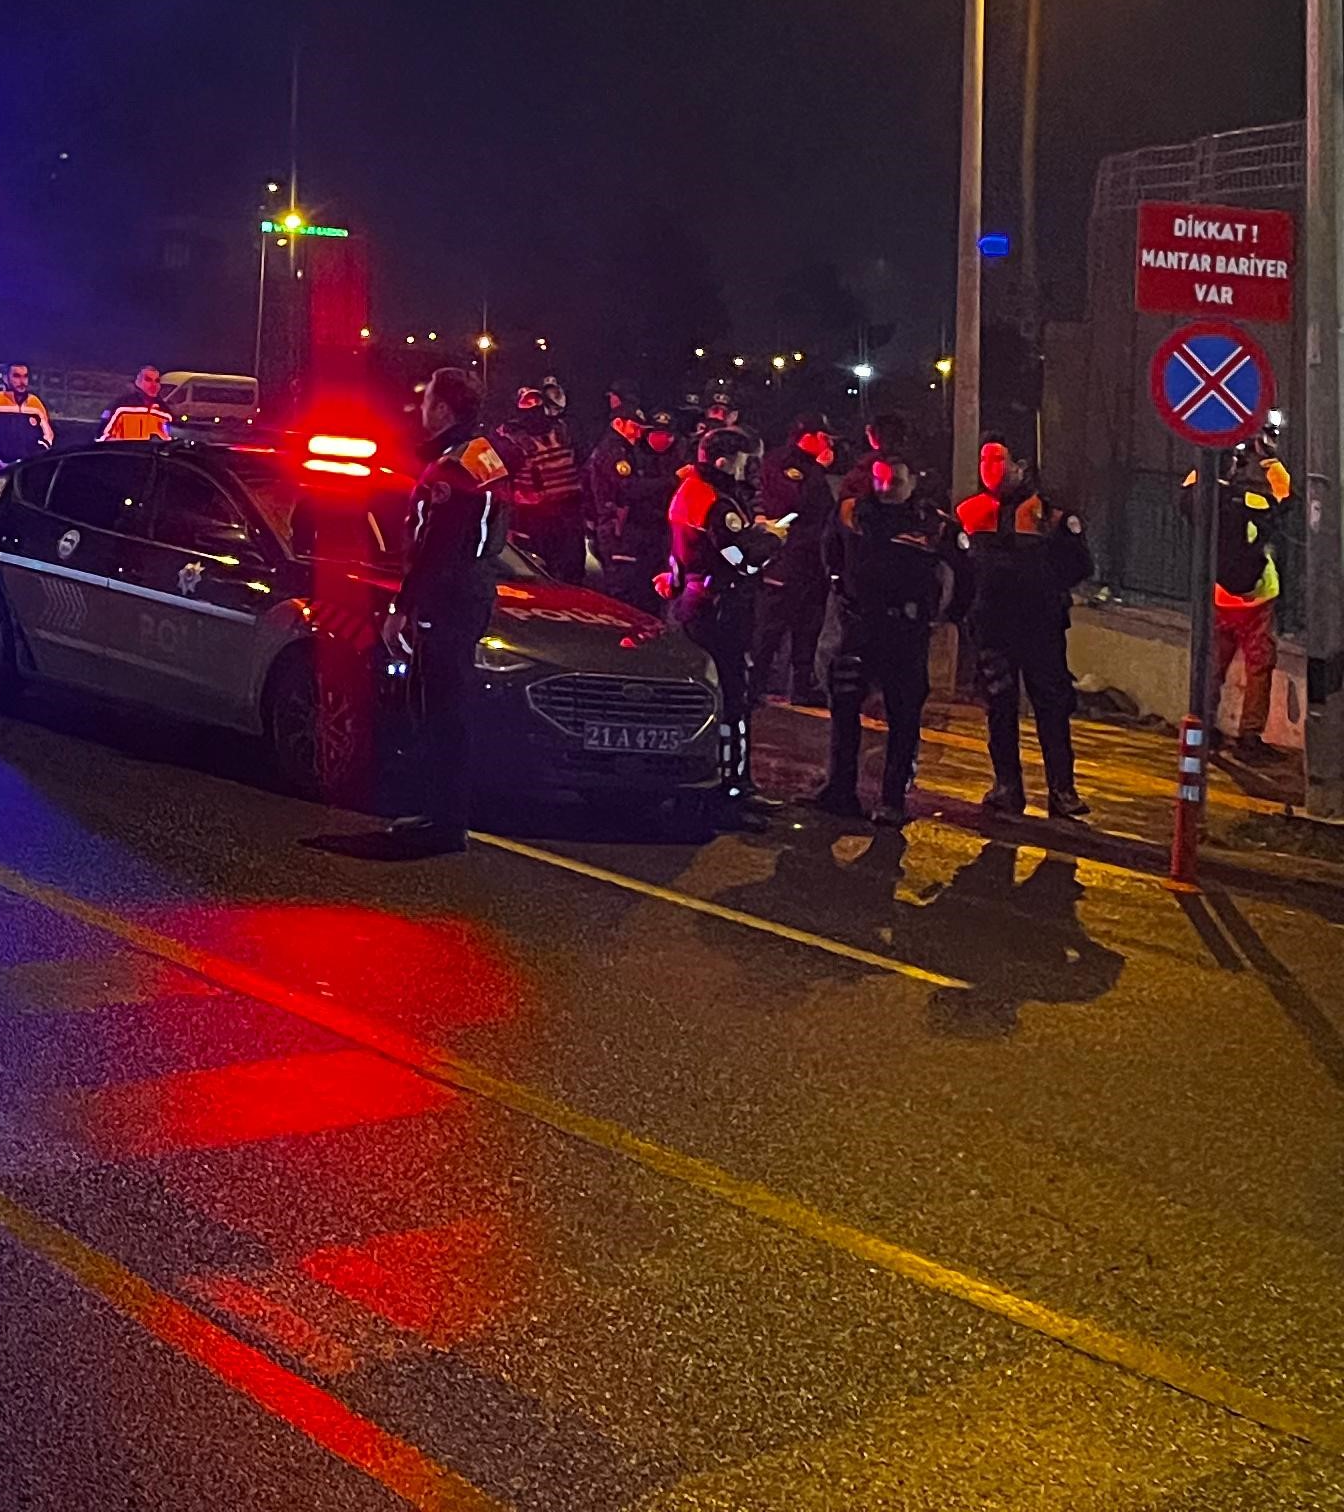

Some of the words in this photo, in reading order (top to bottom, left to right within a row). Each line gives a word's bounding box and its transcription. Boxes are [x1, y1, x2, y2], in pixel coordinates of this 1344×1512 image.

[1173, 214, 1246, 242] DİKKAT
[1251, 225, 1258, 243] !
[1141, 248, 1211, 272] MANTAR
[1215, 253, 1288, 279] BARİYER
[1194, 283, 1234, 305] VAR
[587, 726, 612, 747] 21
[616, 728, 631, 748] A
